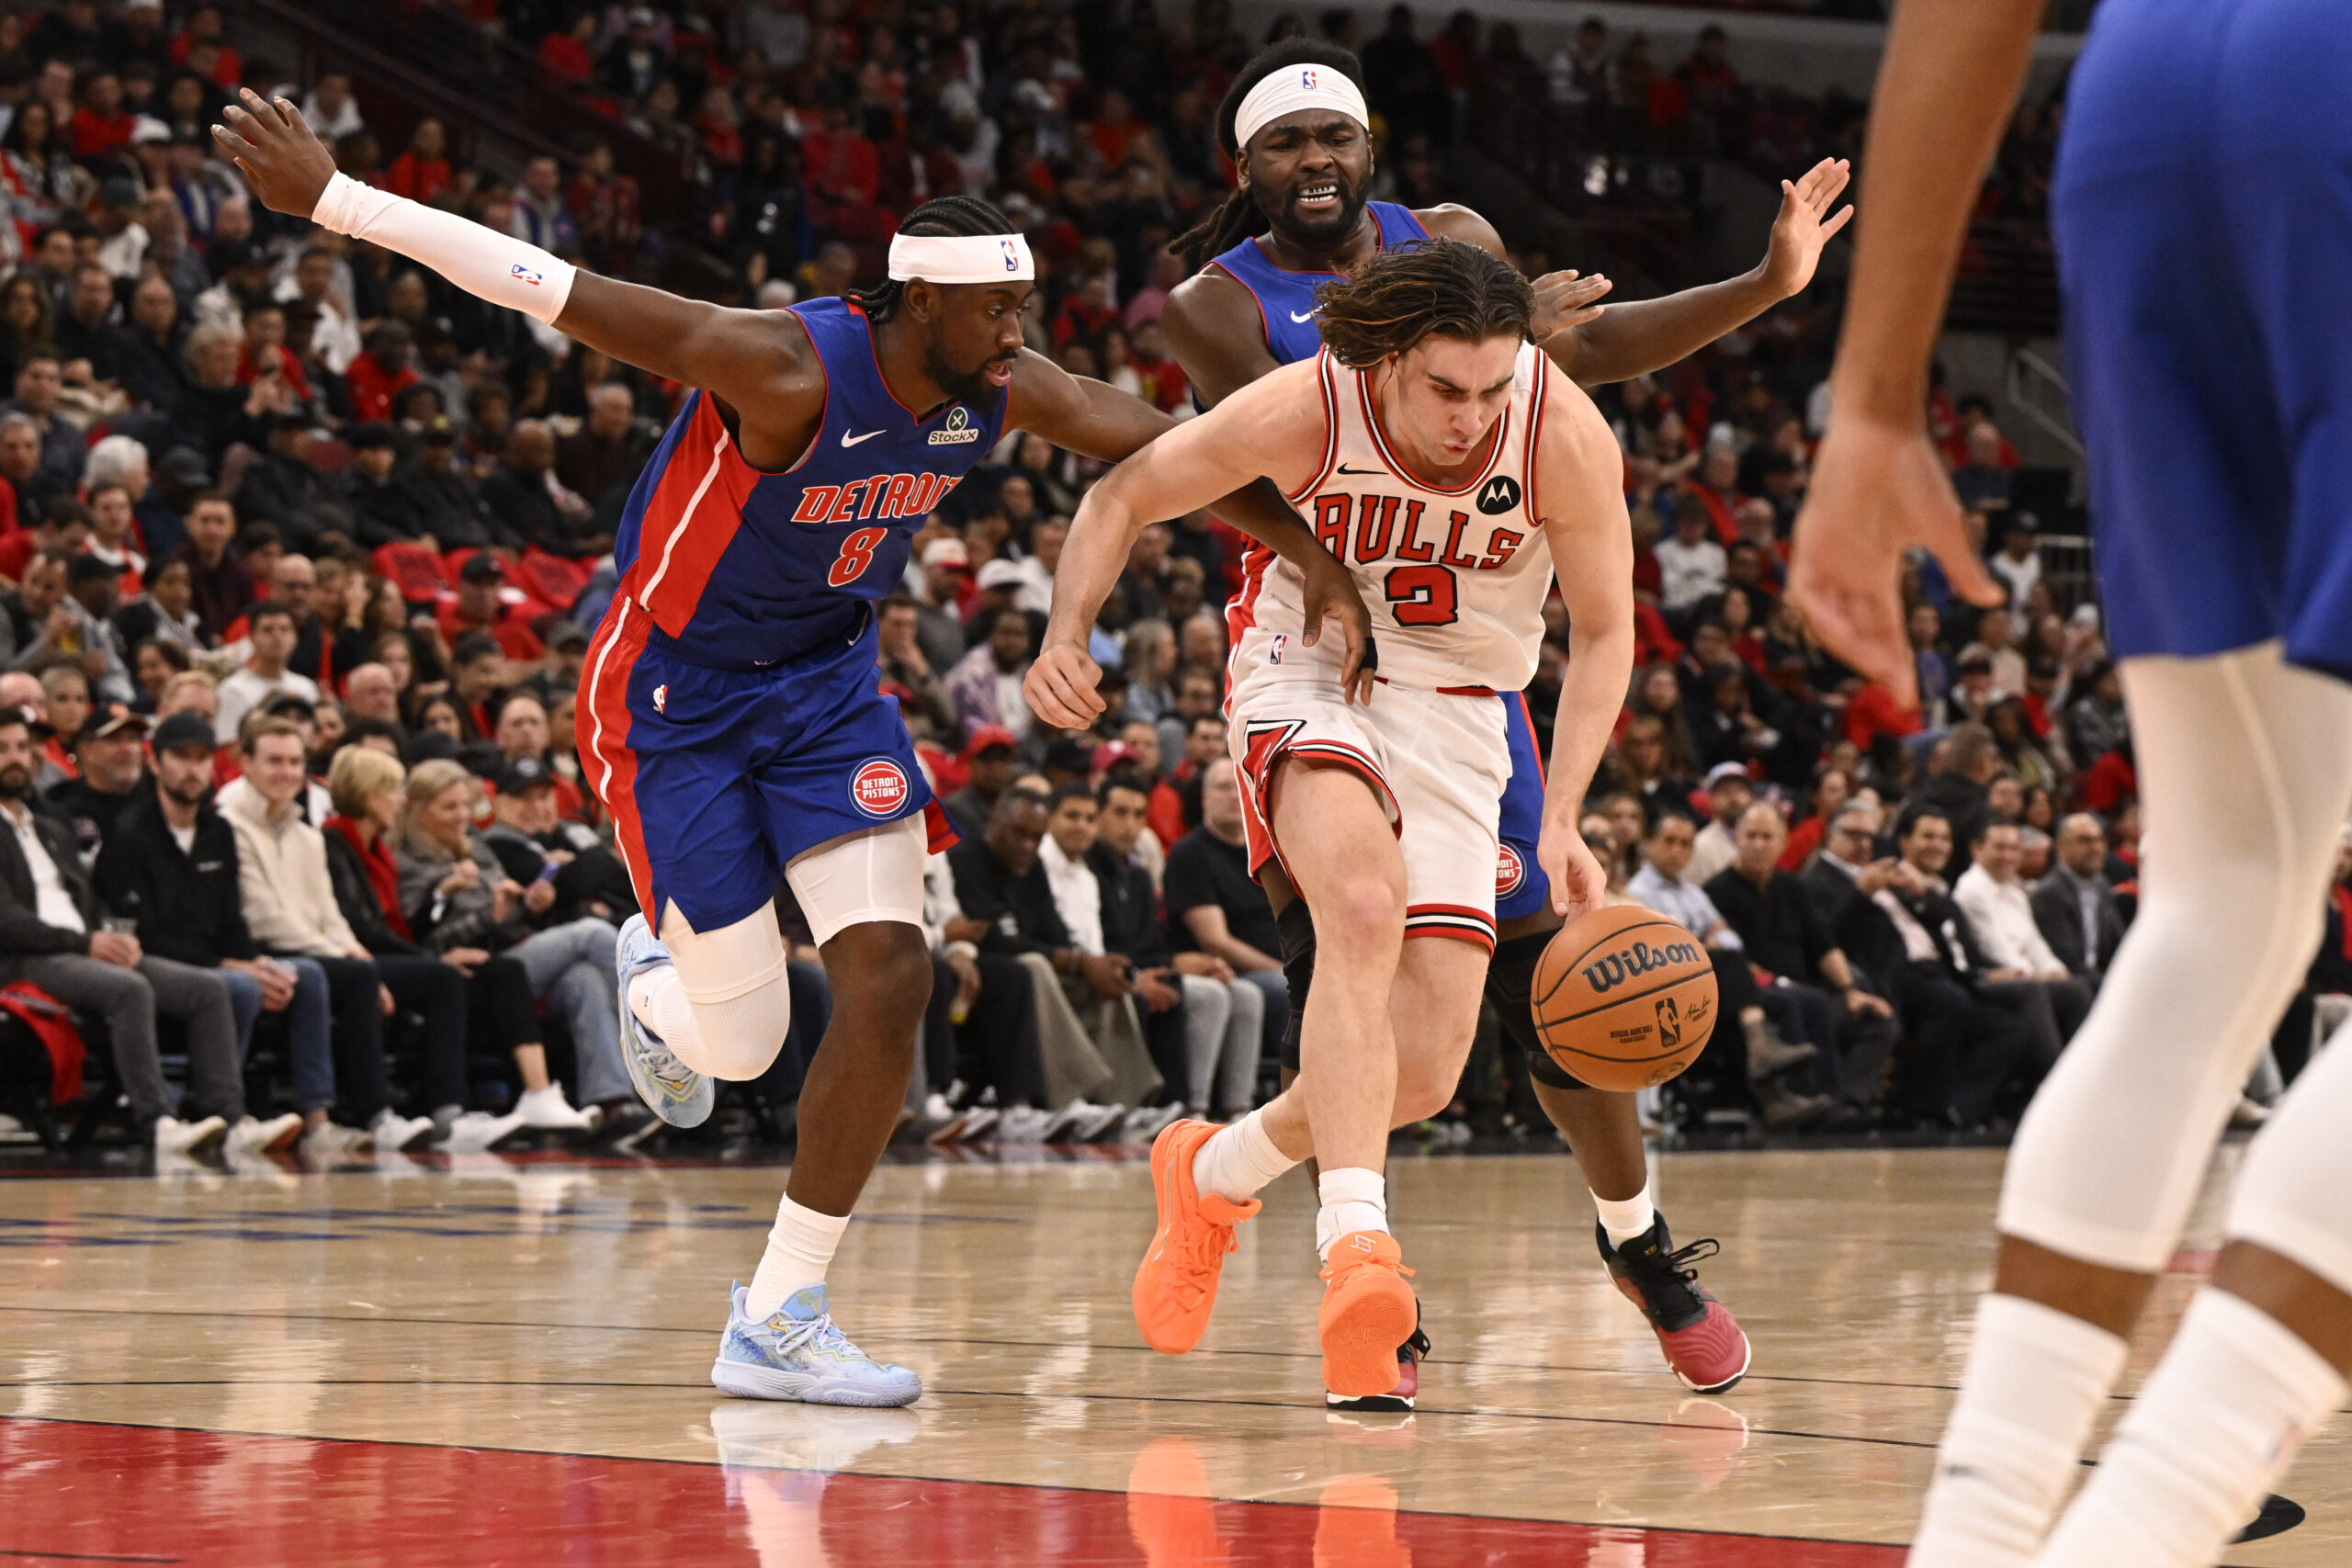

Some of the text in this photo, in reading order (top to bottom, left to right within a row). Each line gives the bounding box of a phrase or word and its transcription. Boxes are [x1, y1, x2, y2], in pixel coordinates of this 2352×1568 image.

[930, 431, 977, 443] StockX
[1314, 492, 1524, 570] BULLS
[828, 527, 888, 587] 8
[861, 776, 899, 789] DETROIT
[862, 786, 900, 799] PISTONS
[1581, 942, 1701, 993] Wilson
